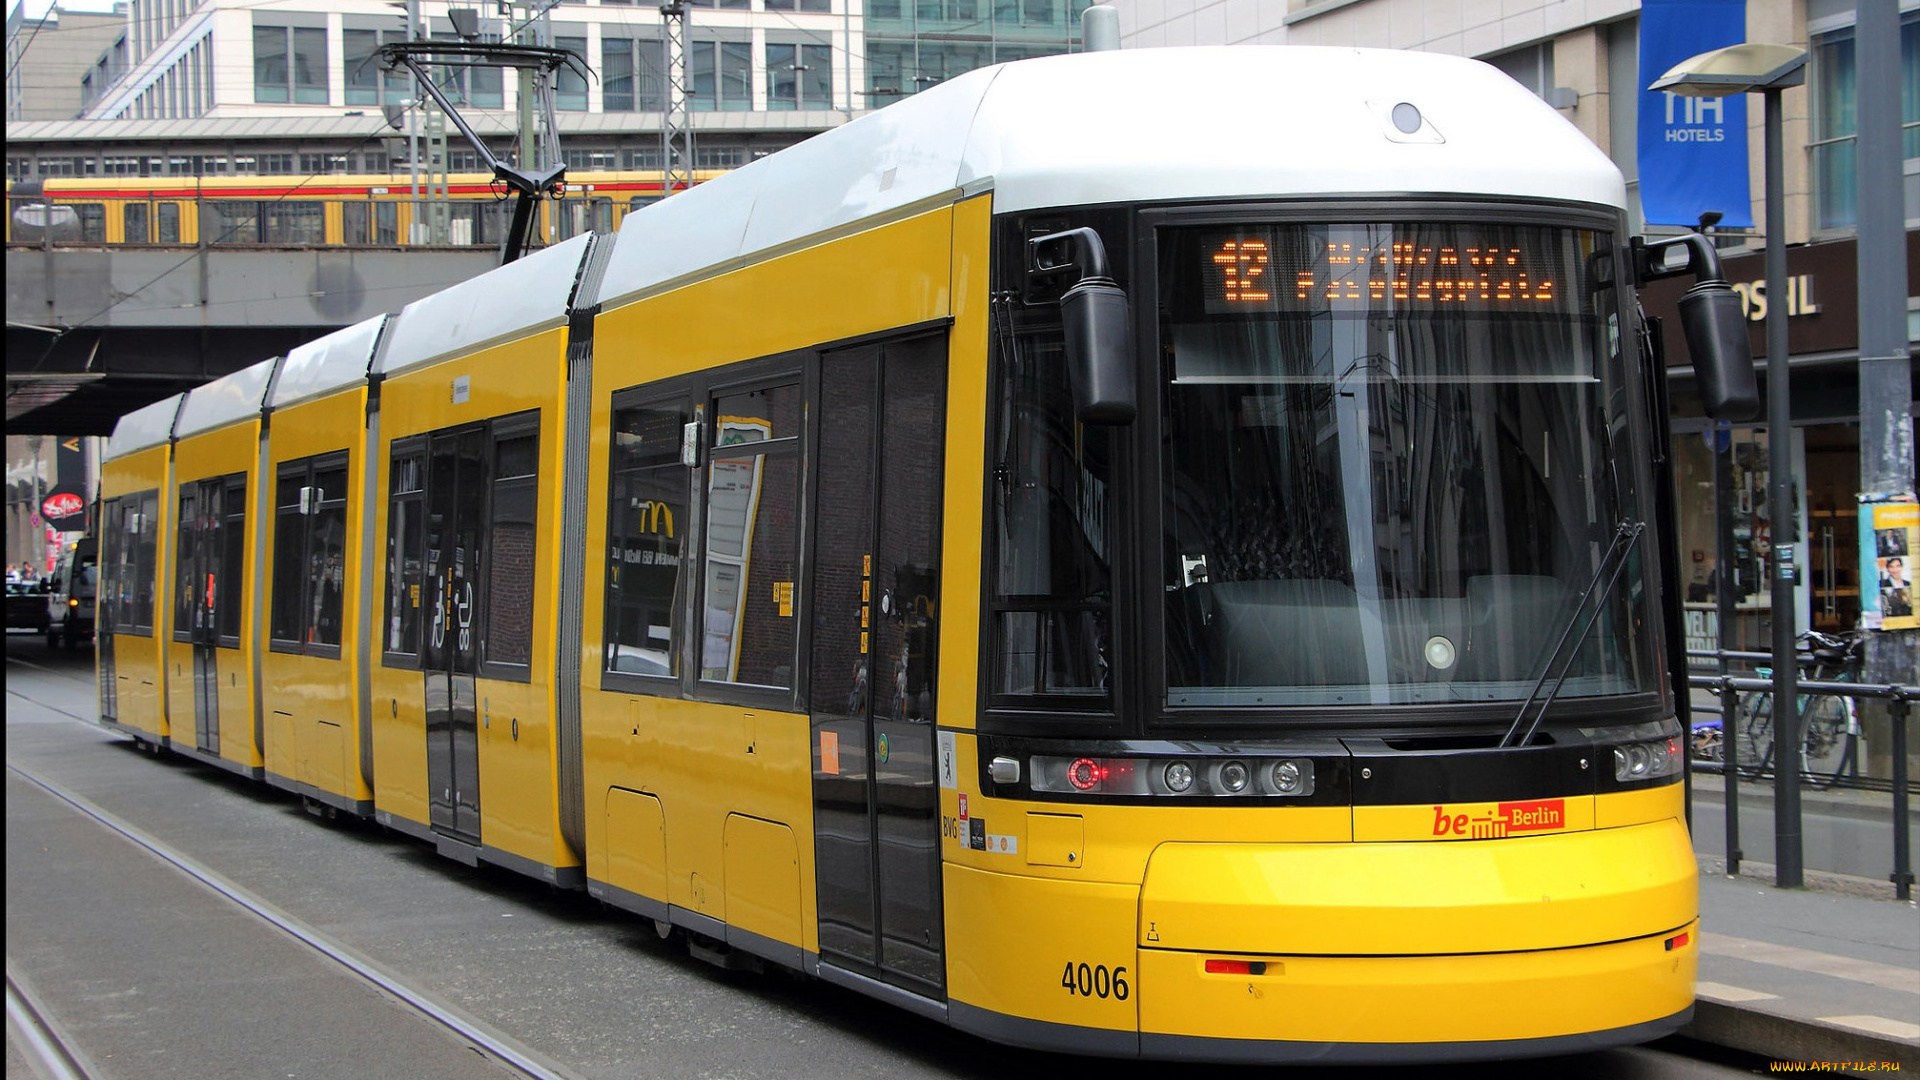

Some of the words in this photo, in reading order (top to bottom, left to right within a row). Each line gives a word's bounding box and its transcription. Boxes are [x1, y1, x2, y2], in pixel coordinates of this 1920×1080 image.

[1665, 128, 1725, 142] HOTELS
[1213, 240, 1269, 301] 12
[943, 815, 958, 839] BVG
[1433, 806, 1469, 836] be
[1512, 807, 1560, 826] Berlin
[1062, 961, 1130, 1001] 4006
